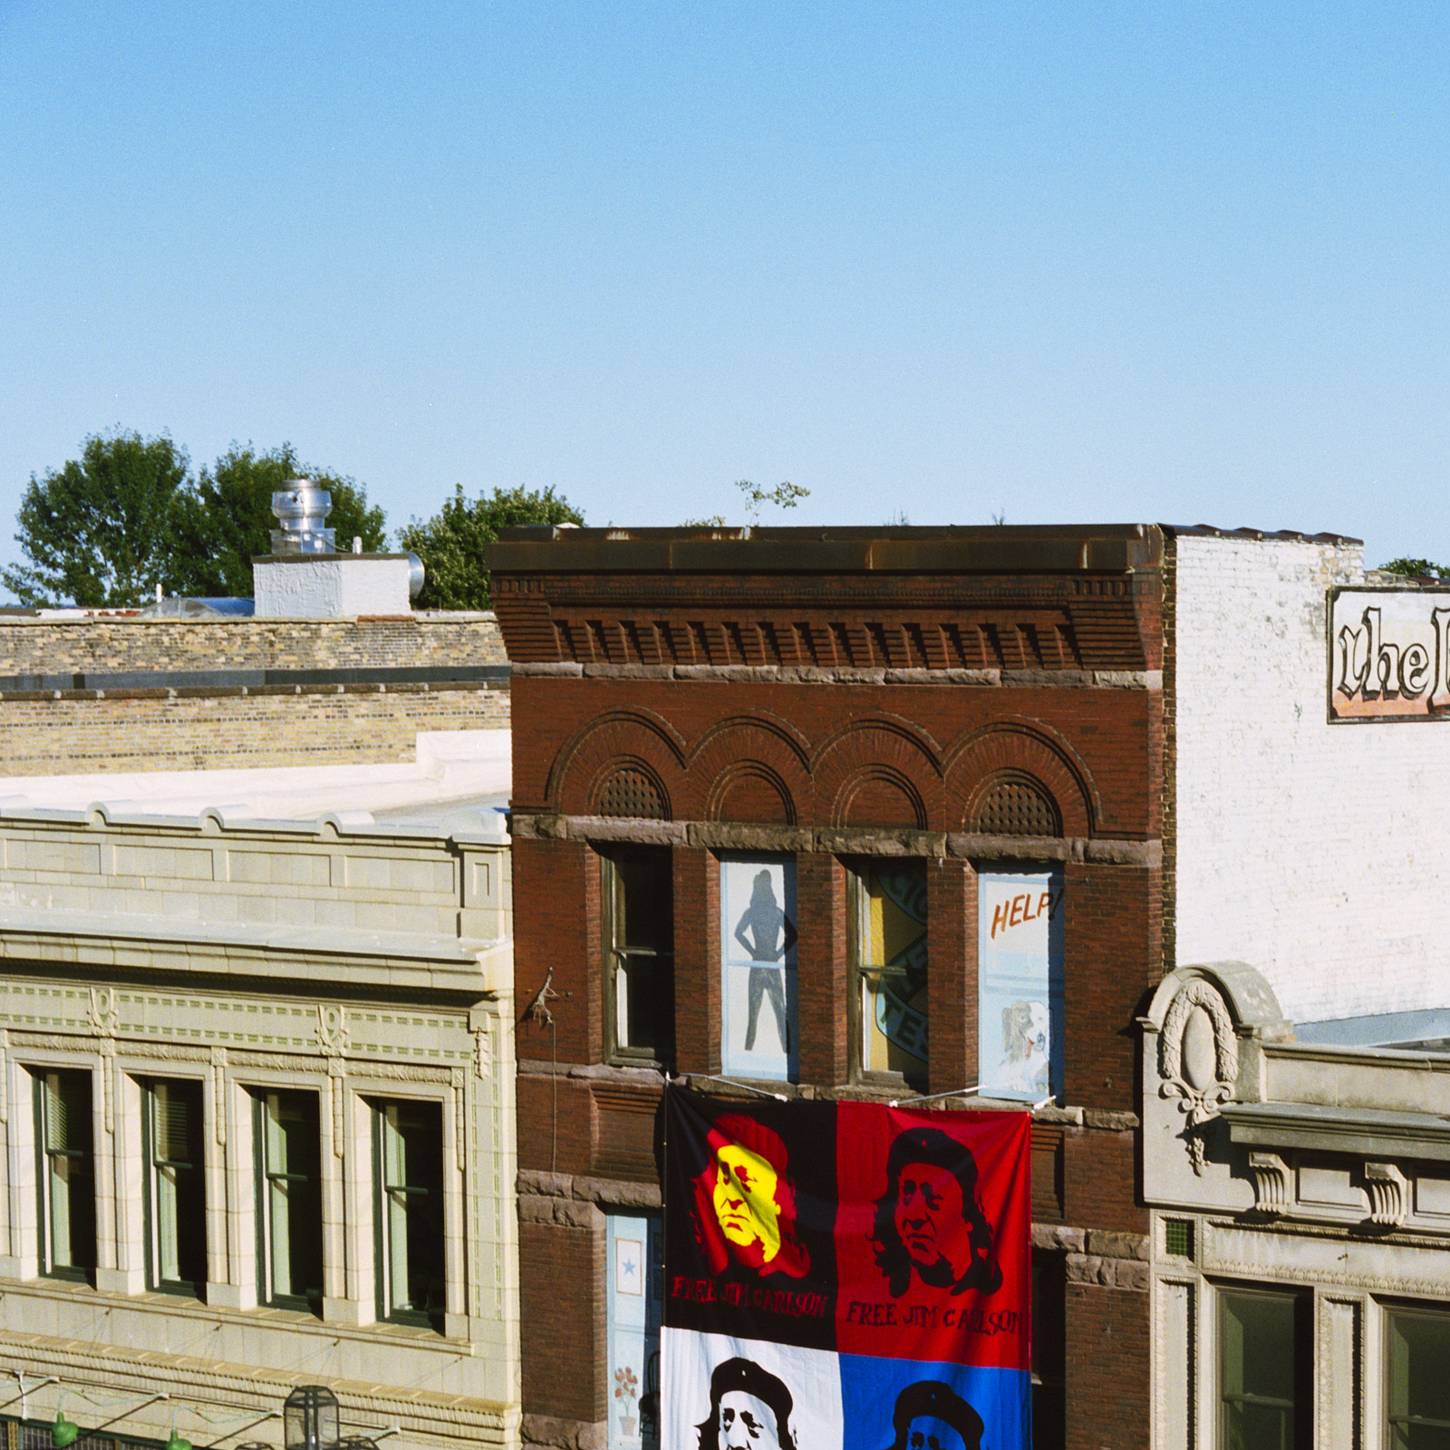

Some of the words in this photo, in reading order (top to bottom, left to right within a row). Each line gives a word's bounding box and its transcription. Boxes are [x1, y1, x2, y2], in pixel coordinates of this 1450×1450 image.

[991, 888, 1064, 940] HELP!
[671, 1275, 718, 1305] FREE
[846, 1301, 898, 1327] FREE
[902, 1305, 940, 1330] JIM
[943, 1308, 1024, 1337] CARLSON
